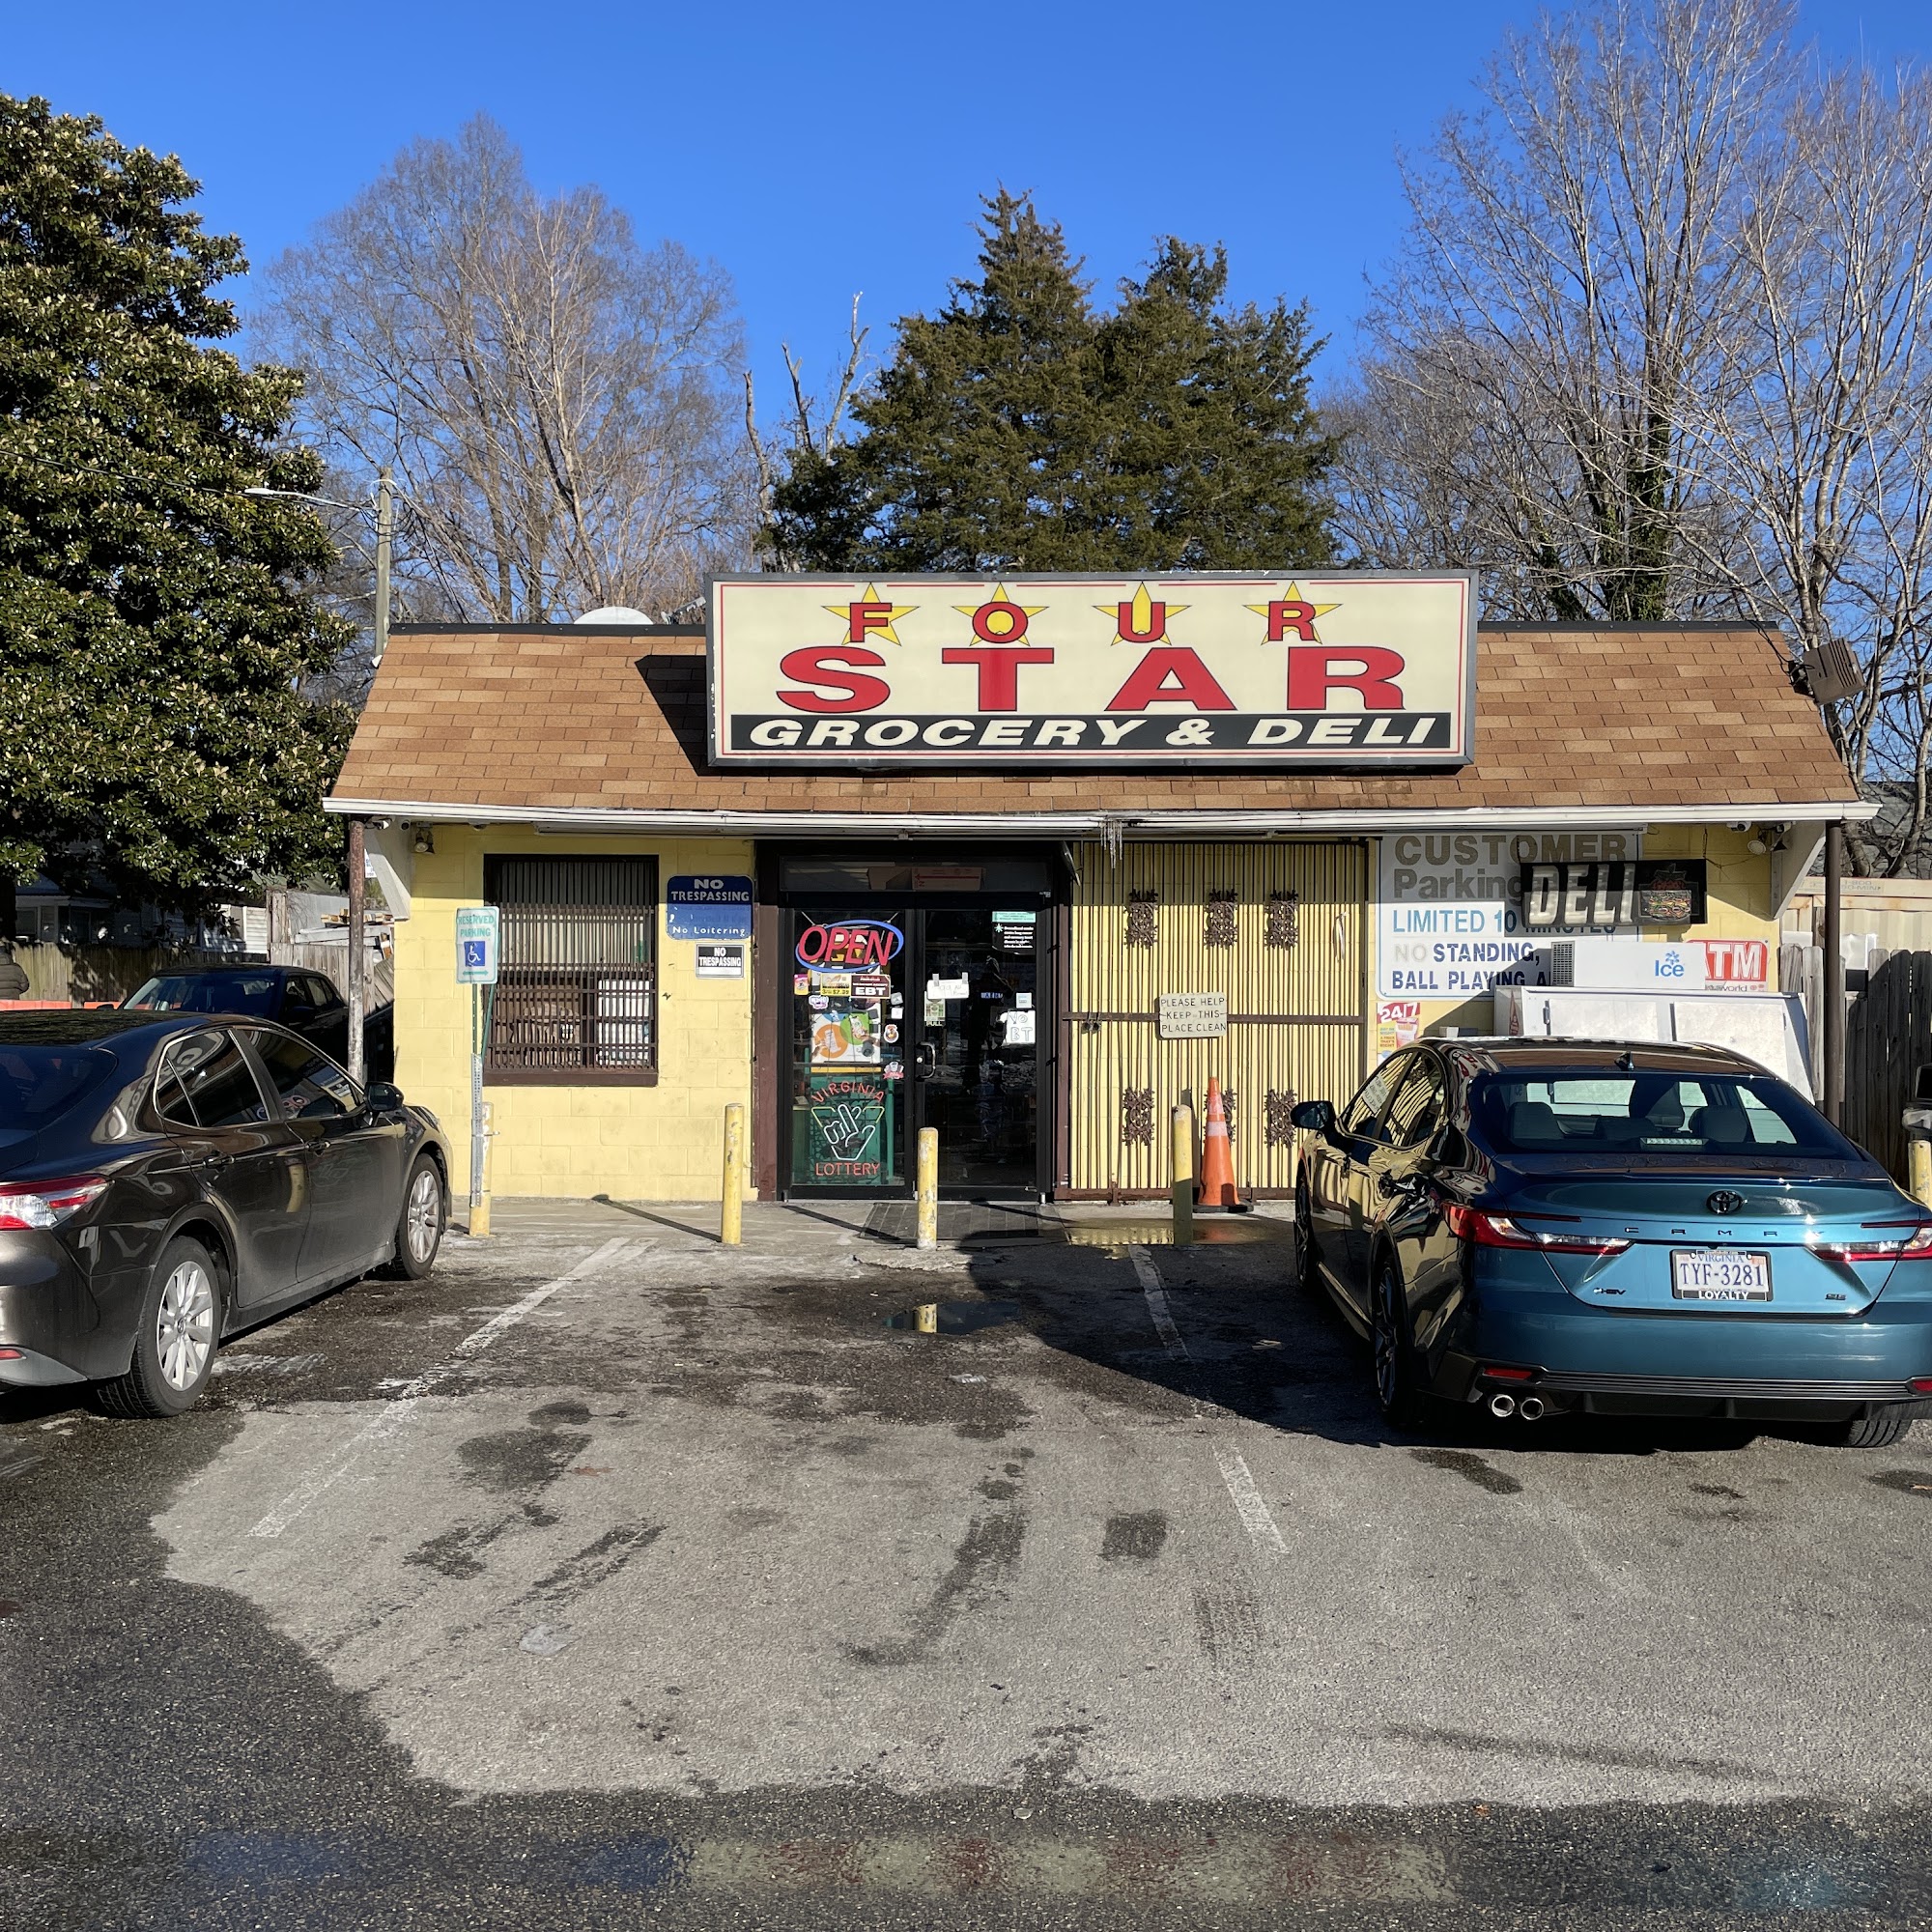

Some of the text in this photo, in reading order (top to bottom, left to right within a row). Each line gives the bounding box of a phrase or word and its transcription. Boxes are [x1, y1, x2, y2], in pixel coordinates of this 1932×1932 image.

[848, 601, 1317, 643] FOUR
[776, 645, 1406, 713] STAR
[750, 716, 1437, 748] GROCERY & DELI
[1394, 835, 1627, 866] CUSTOMER
[694, 879, 724, 890] NO
[1394, 868, 1522, 907] Parking
[670, 891, 750, 901] TRESPASSING
[1529, 863, 1636, 925] DELI
[457, 915, 495, 925] RESERVED
[1393, 910, 1518, 933] LIMITED 10
[460, 927, 491, 938] PARKING
[672, 926, 746, 937] No Loitering
[714, 947, 726, 957] NO
[798, 925, 895, 966] OPEN
[698, 956, 742, 967] TRESPASSING
[1433, 942, 1540, 966] STANDING,
[1655, 959, 1685, 978] Ice
[1392, 971, 1551, 990] BALL PLAYING A
[855, 986, 886, 996] EBT
[1161, 997, 1225, 1008] PLEASE HELP
[1166, 1009, 1220, 1020] KEEP THIS
[1161, 1023, 1227, 1033] PLACE CLEAN
[811, 1080, 884, 1102] VIRGINIA
[815, 1162, 881, 1177] LOTTERY
[1696, 1254, 1745, 1264] VIRGINIA
[1679, 1263, 1764, 1287] TYF-3281
[1698, 1291, 1749, 1300] LOYALTY
